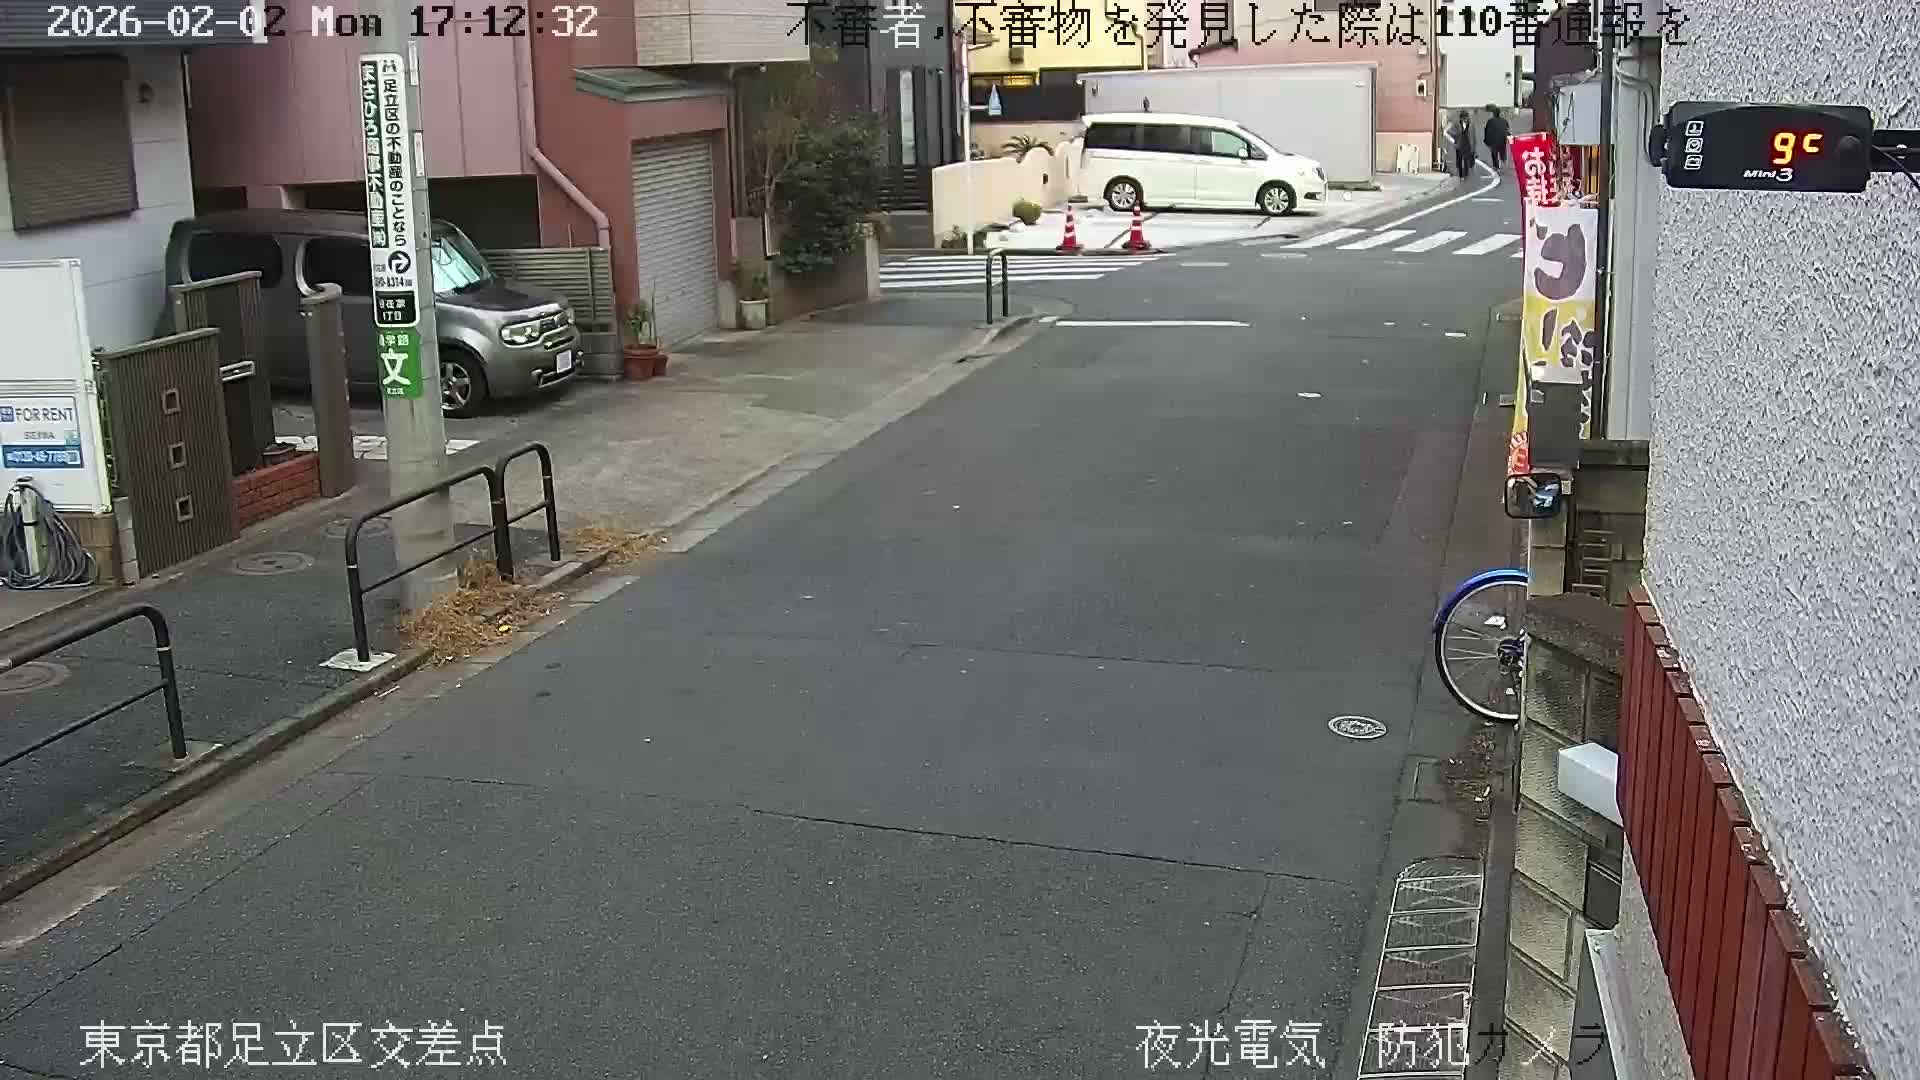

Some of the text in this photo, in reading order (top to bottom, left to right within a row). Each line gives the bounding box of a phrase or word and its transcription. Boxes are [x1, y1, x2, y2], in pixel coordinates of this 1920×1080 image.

[383, 78, 407, 247] 足立区の不動産のことなら
[380, 348, 412, 385] 文
[16, 408, 40, 421] FOR
[42, 408, 73, 421] RENT
